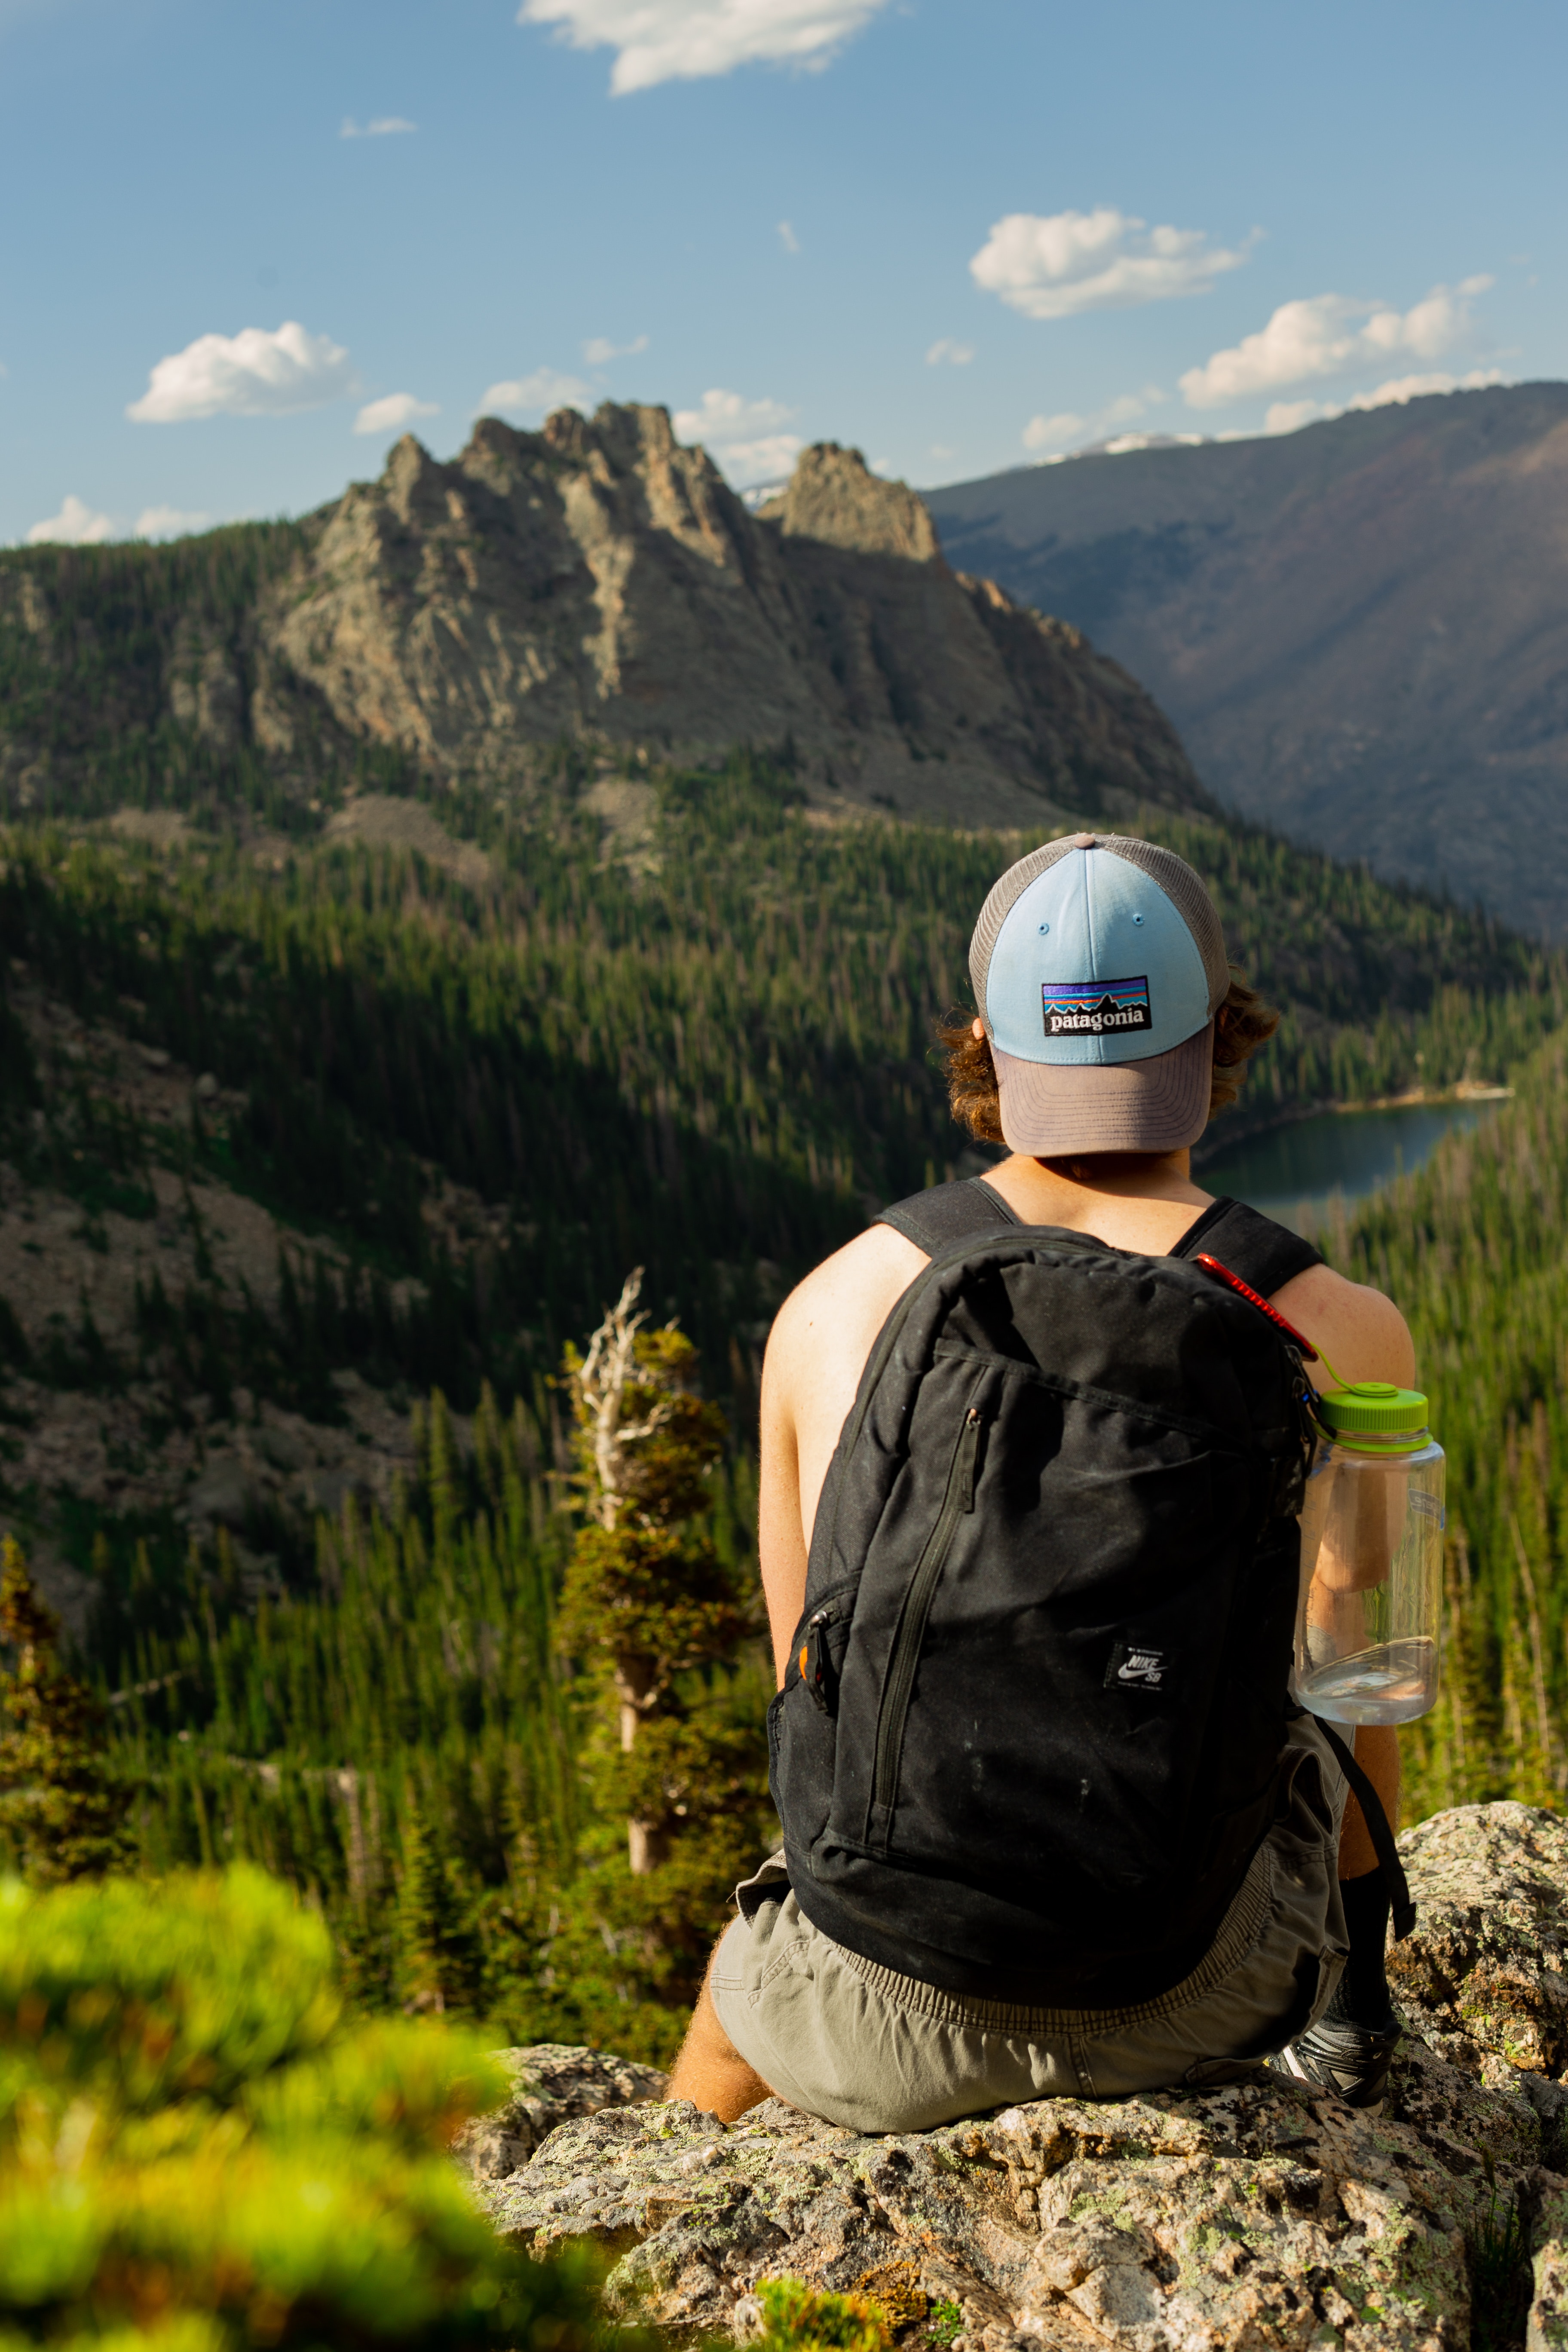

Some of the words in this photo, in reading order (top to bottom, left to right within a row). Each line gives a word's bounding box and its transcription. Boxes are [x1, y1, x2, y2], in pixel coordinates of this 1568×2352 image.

[1050, 1008, 1144, 1032] patagonia
[1128, 1654, 1159, 1669] NIKE
[1145, 1672, 1162, 1683] SB
